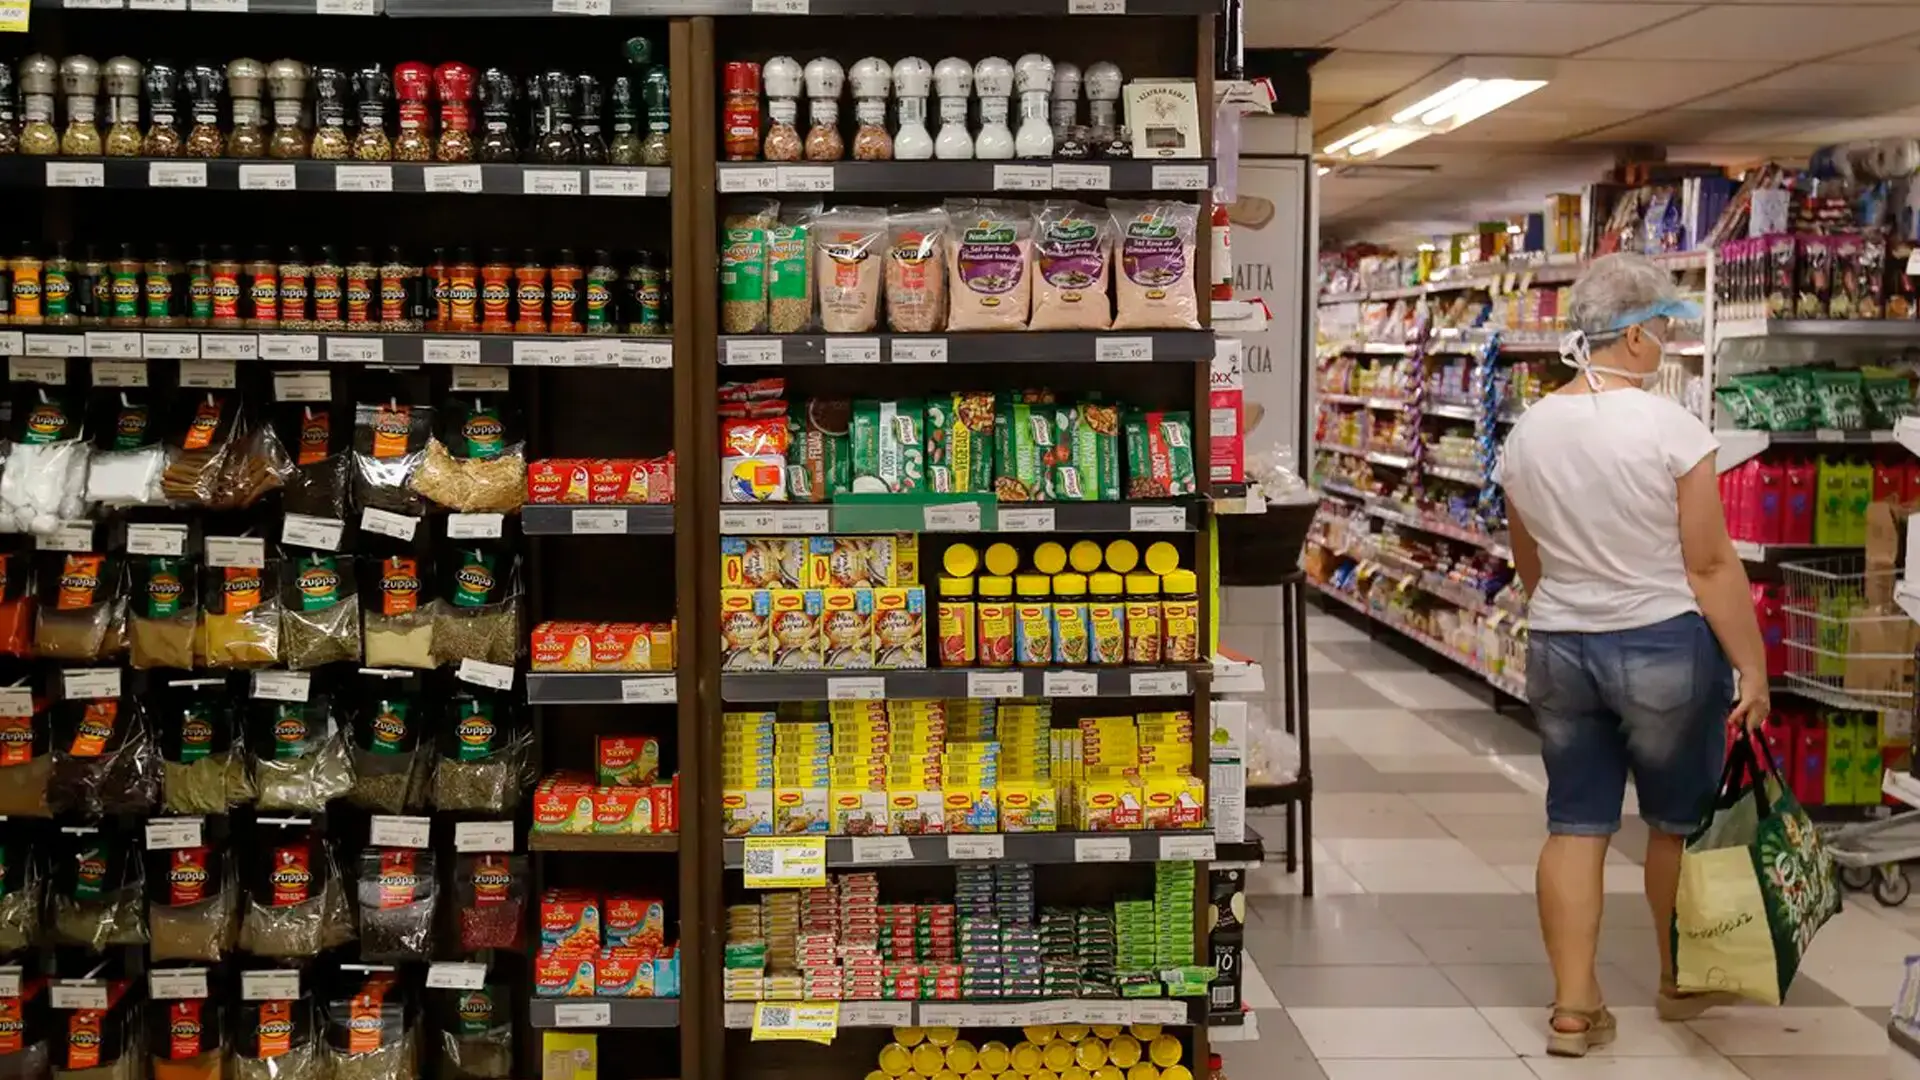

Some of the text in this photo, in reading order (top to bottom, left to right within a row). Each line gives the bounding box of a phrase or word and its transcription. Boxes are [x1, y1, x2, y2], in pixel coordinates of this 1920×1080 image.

[466, 424, 501, 436] Zuppa
[954, 430, 968, 472] VEGETAIS
[881, 450, 895, 477] ARROZ
[61, 576, 97, 589] Zuppa
[300, 575, 336, 588] Zuppa
[383, 579, 418, 590] Zuppa
[458, 570, 492, 587] Zuppa
[149, 582, 180, 594] Zuppa
[224, 578, 260, 592] Zuppa
[373, 718, 404, 735] Zuppa
[458, 725, 492, 736] Zuppa
[170, 870, 205, 882] Zuppa
[274, 872, 309, 883] Zuppa
[379, 874, 415, 886] Zuppa
[474, 874, 510, 886] Zuppa
